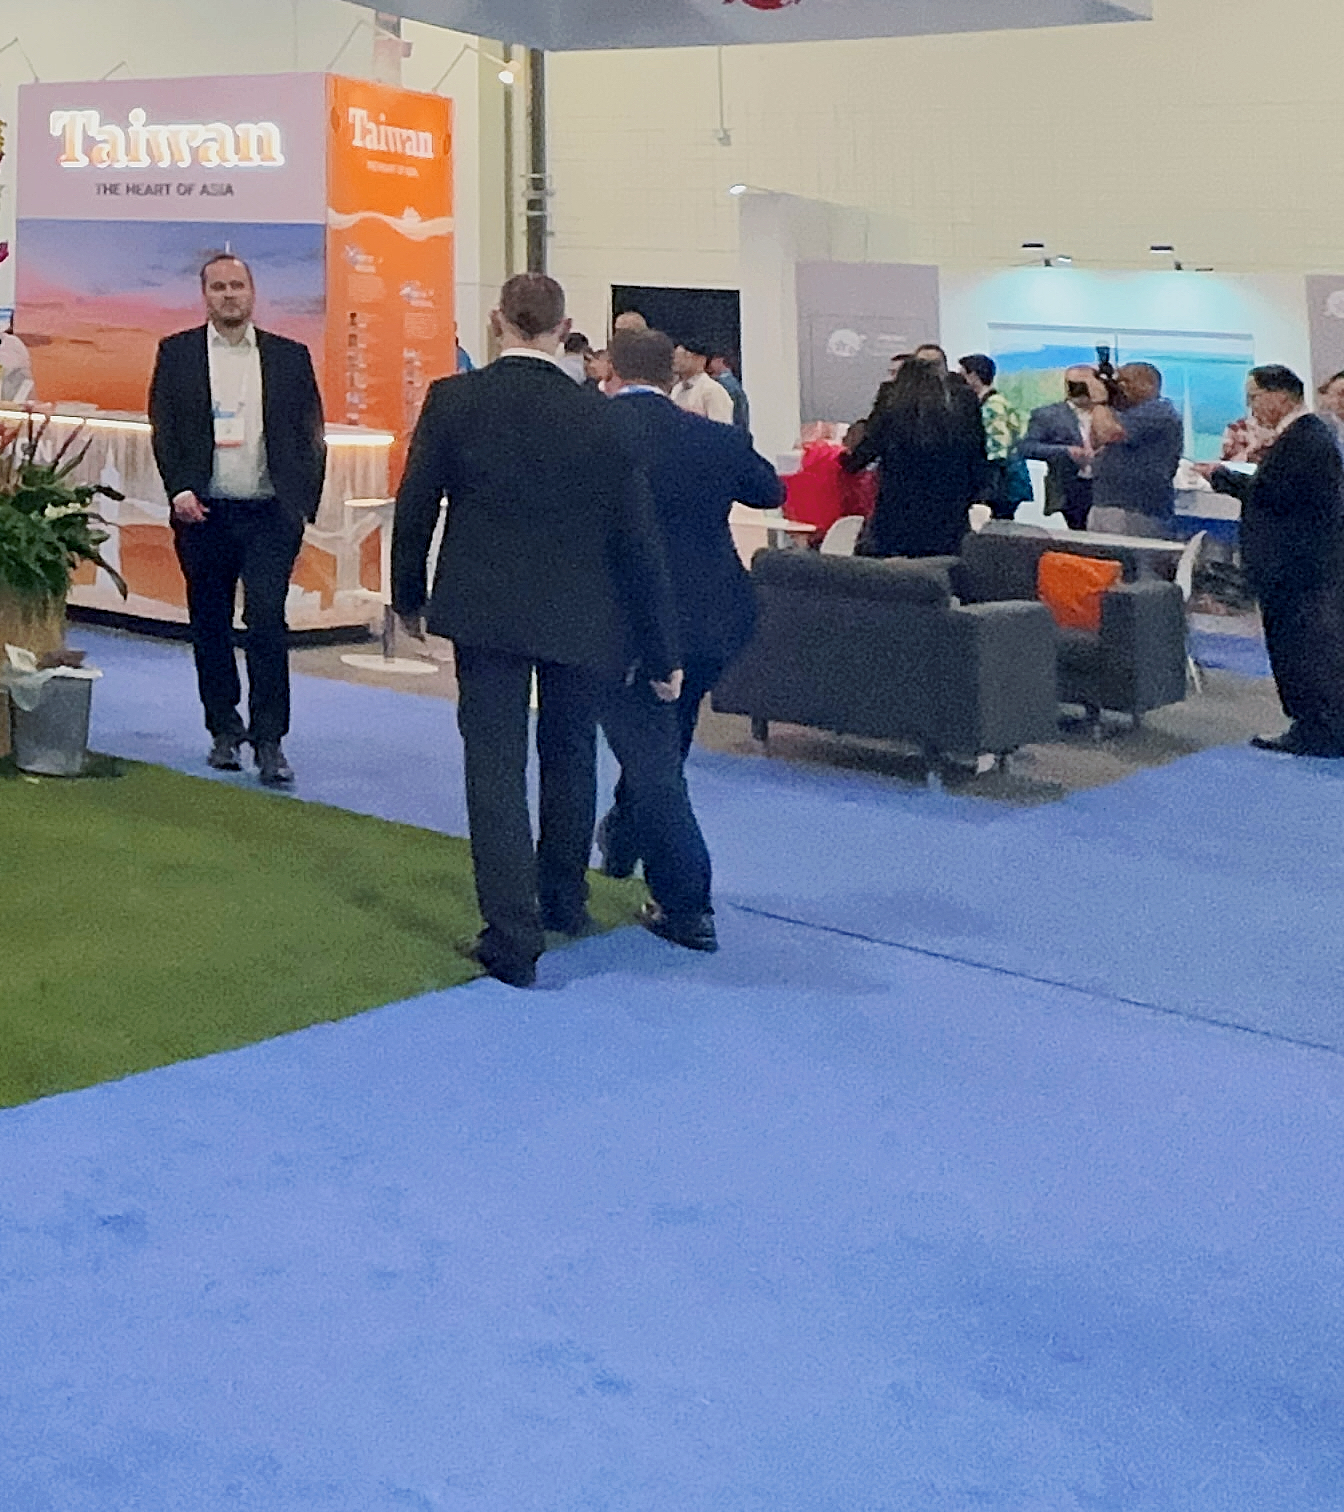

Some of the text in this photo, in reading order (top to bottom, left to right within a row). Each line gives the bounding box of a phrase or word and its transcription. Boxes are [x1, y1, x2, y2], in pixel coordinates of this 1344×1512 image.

[49, 107, 286, 168] Taiwan
[348, 106, 434, 160] Taiwan
[94, 182, 235, 197] THE HEART OF ASIA
